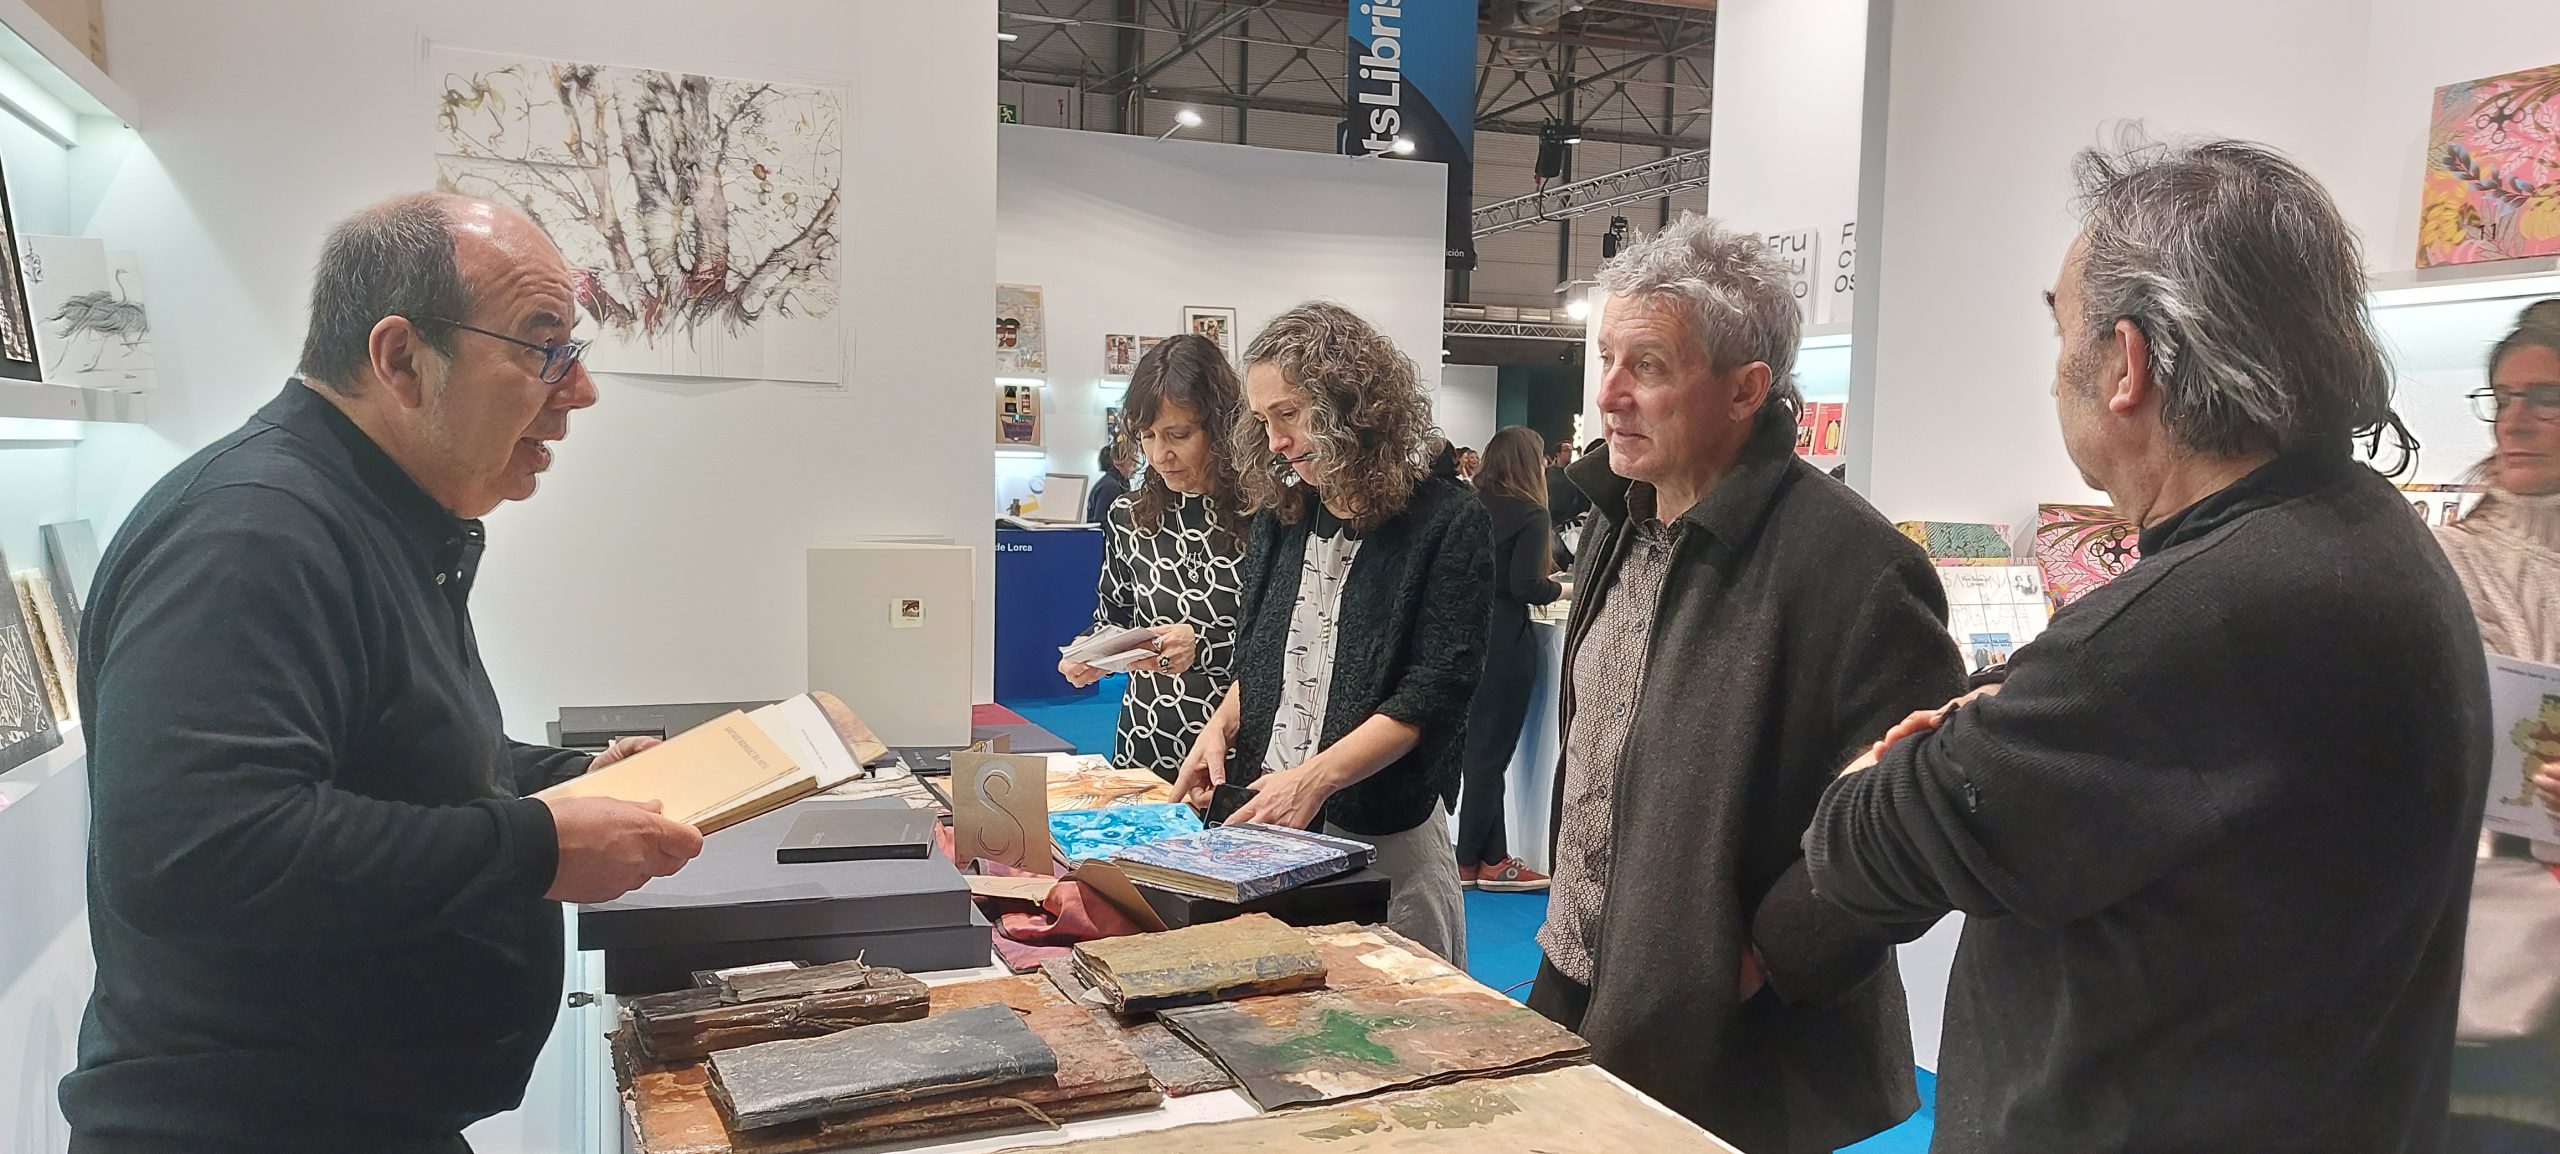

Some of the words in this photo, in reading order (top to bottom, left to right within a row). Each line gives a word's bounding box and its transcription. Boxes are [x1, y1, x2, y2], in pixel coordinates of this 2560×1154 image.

[1359, 0, 1401, 159] tsLibri
[1768, 233, 1807, 254] Fru
[1007, 542, 1033, 552] Lorca
